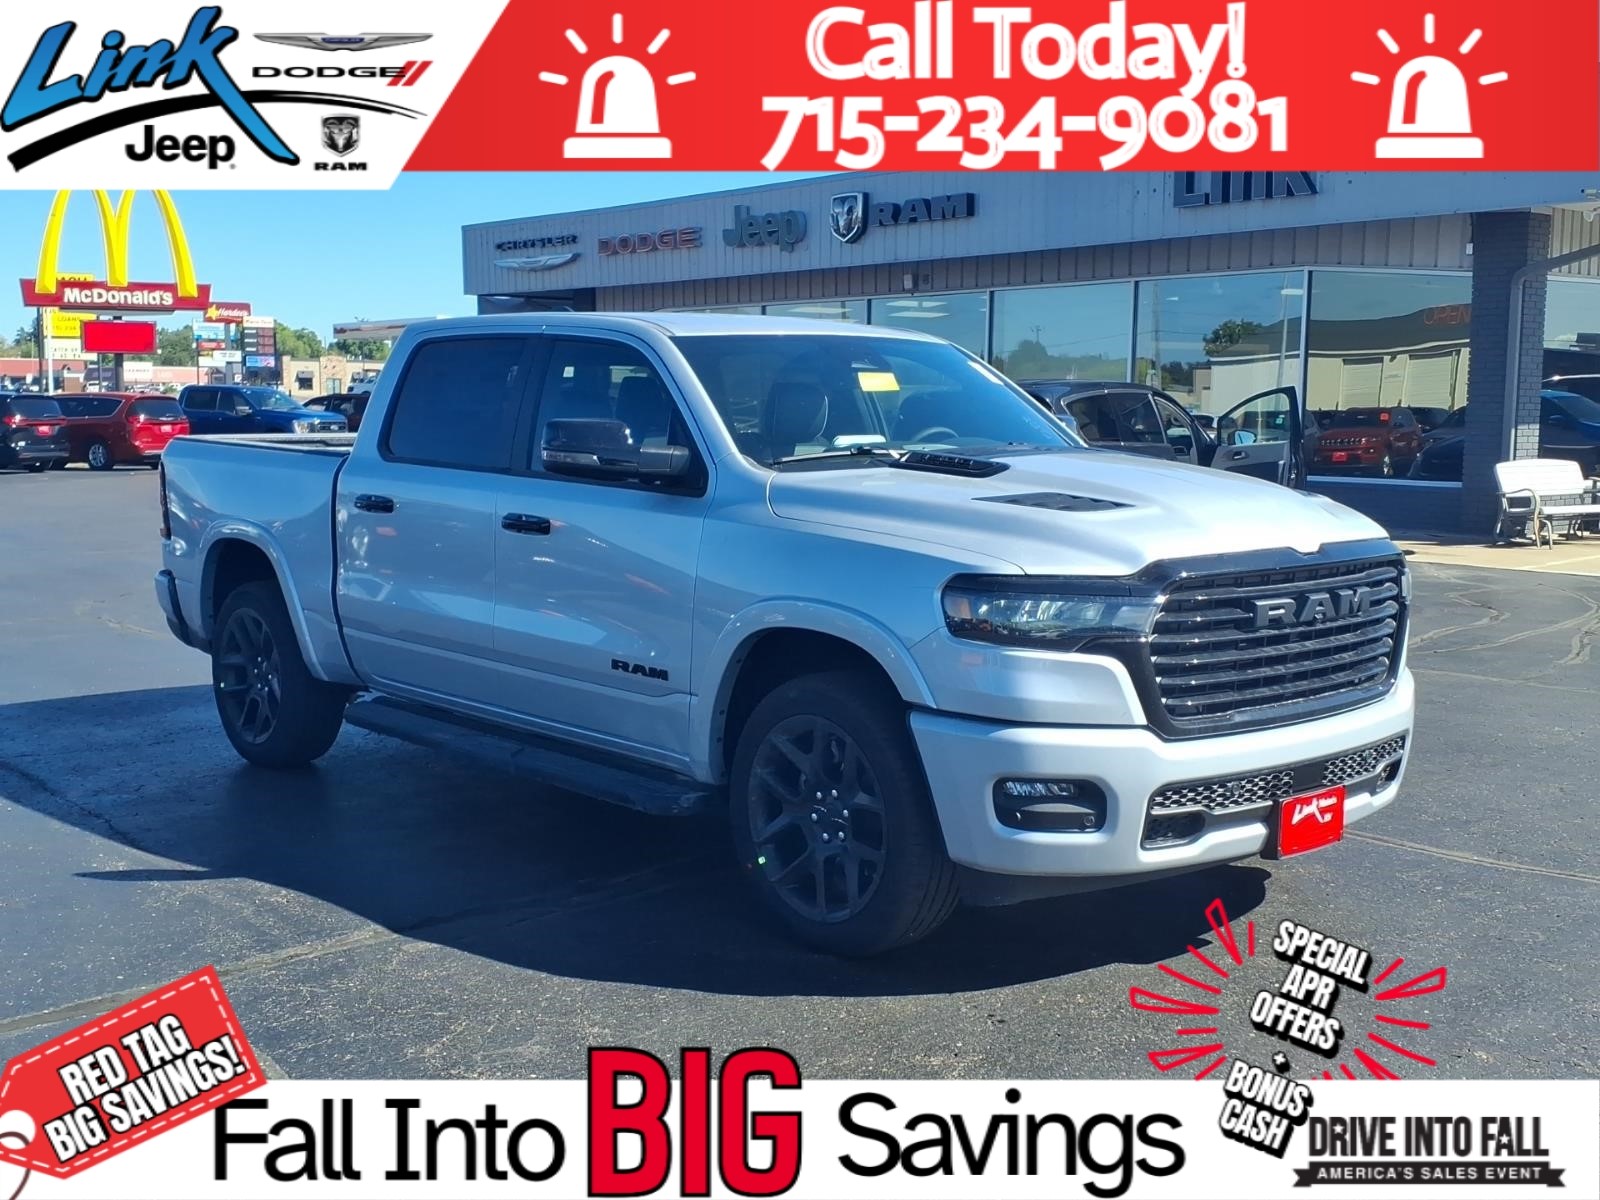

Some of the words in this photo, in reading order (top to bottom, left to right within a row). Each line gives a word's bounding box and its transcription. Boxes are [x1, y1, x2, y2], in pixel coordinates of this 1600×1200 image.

[871, 192, 975, 228] RAM
[598, 226, 702, 256] DODGE
[723, 204, 807, 253] Jeep
[496, 234, 578, 251] CHRYSLER
[64, 287, 174, 306] McDonald's
[1423, 304, 1472, 325] OPEN
[1251, 585, 1371, 628] RAM
[611, 658, 669, 681] RAM
